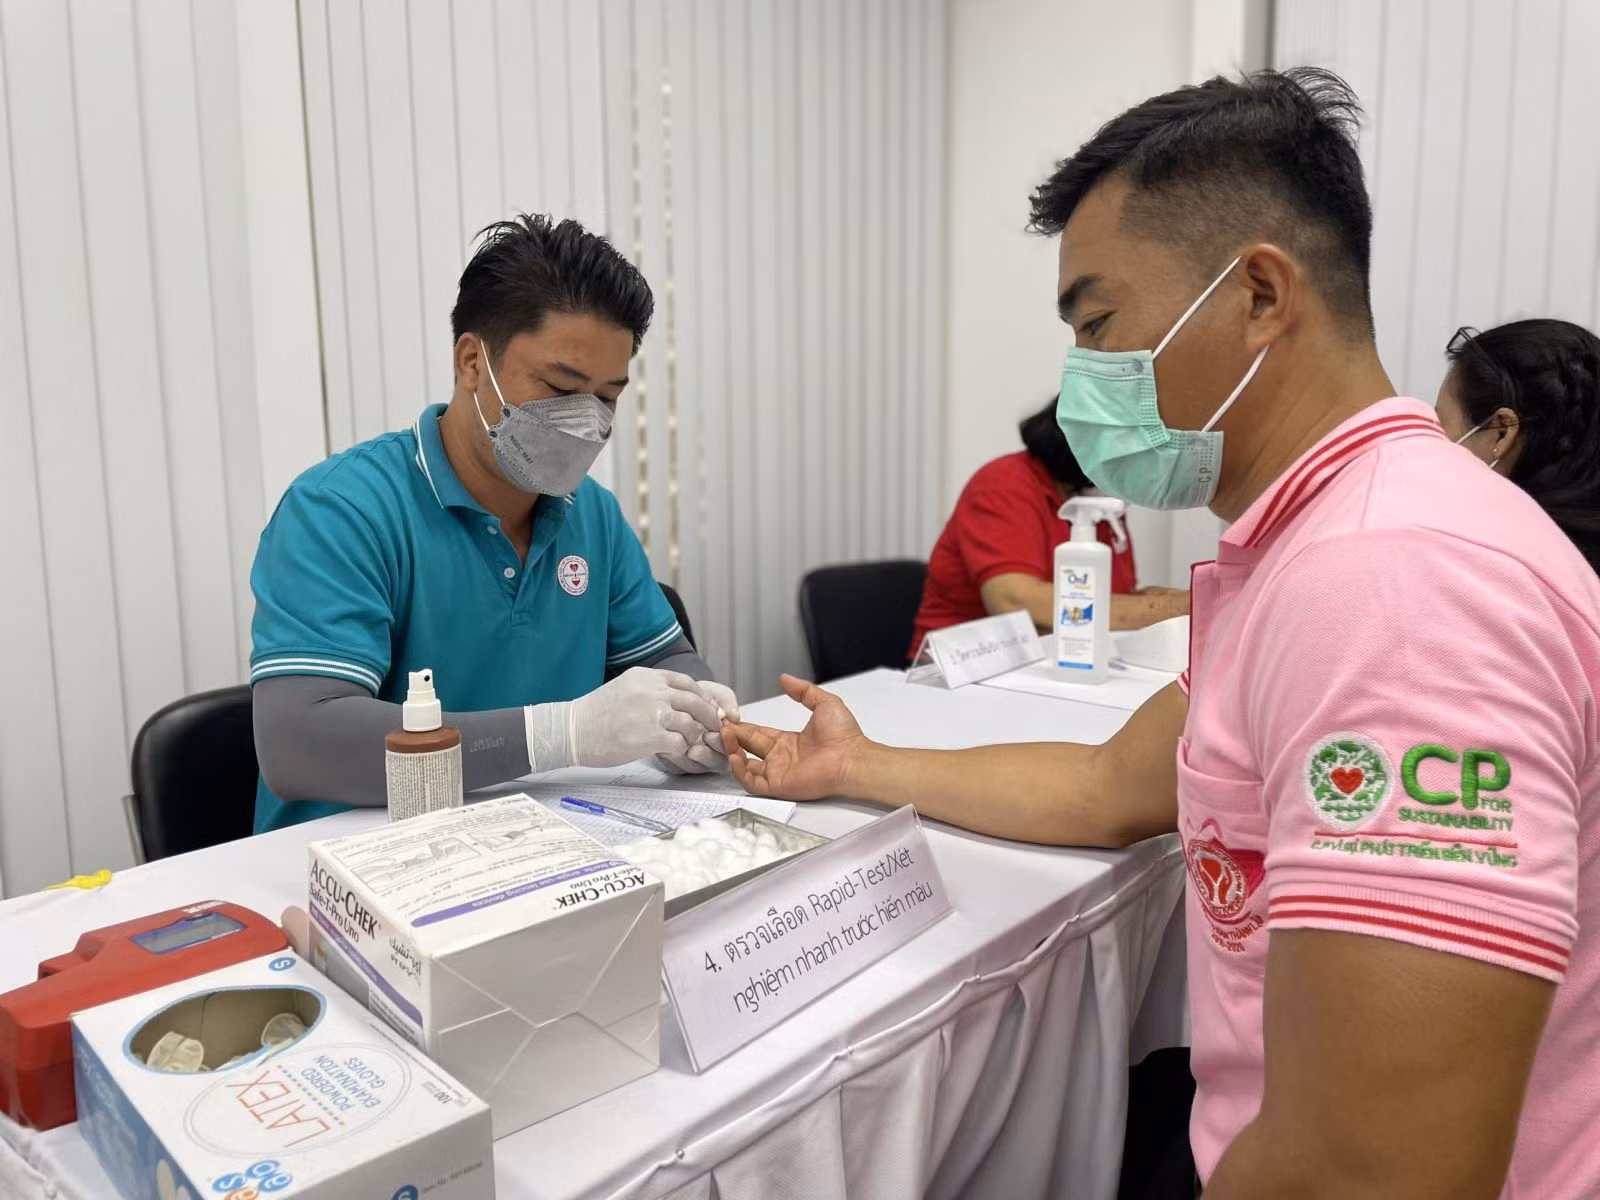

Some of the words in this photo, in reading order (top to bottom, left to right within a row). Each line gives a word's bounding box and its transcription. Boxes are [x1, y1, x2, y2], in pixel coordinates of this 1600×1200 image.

[1400, 742, 1512, 811] CP
[1397, 806, 1514, 832] SUSTAINABILITY
[1481, 796, 1513, 814] FOR
[569, 876, 593, 890] Uno
[343, 915, 360, 944] Uno
[703, 950, 723, 974] 4.
[724, 905, 809, 963] ตรวจเลือด
[807, 846, 915, 918] Rapid-Test/Xét
[733, 963, 796, 1014] nghiệm
[794, 931, 844, 976] nhanh
[840, 914, 879, 946] trước
[874, 896, 907, 926] hiến
[904, 880, 934, 909] máu
[300, 1067, 357, 1113] POWDERED
[312, 1054, 382, 1109] EXAMINATION
[343, 1056, 386, 1089] GLOVES
[225, 1070, 331, 1148] LATEX
